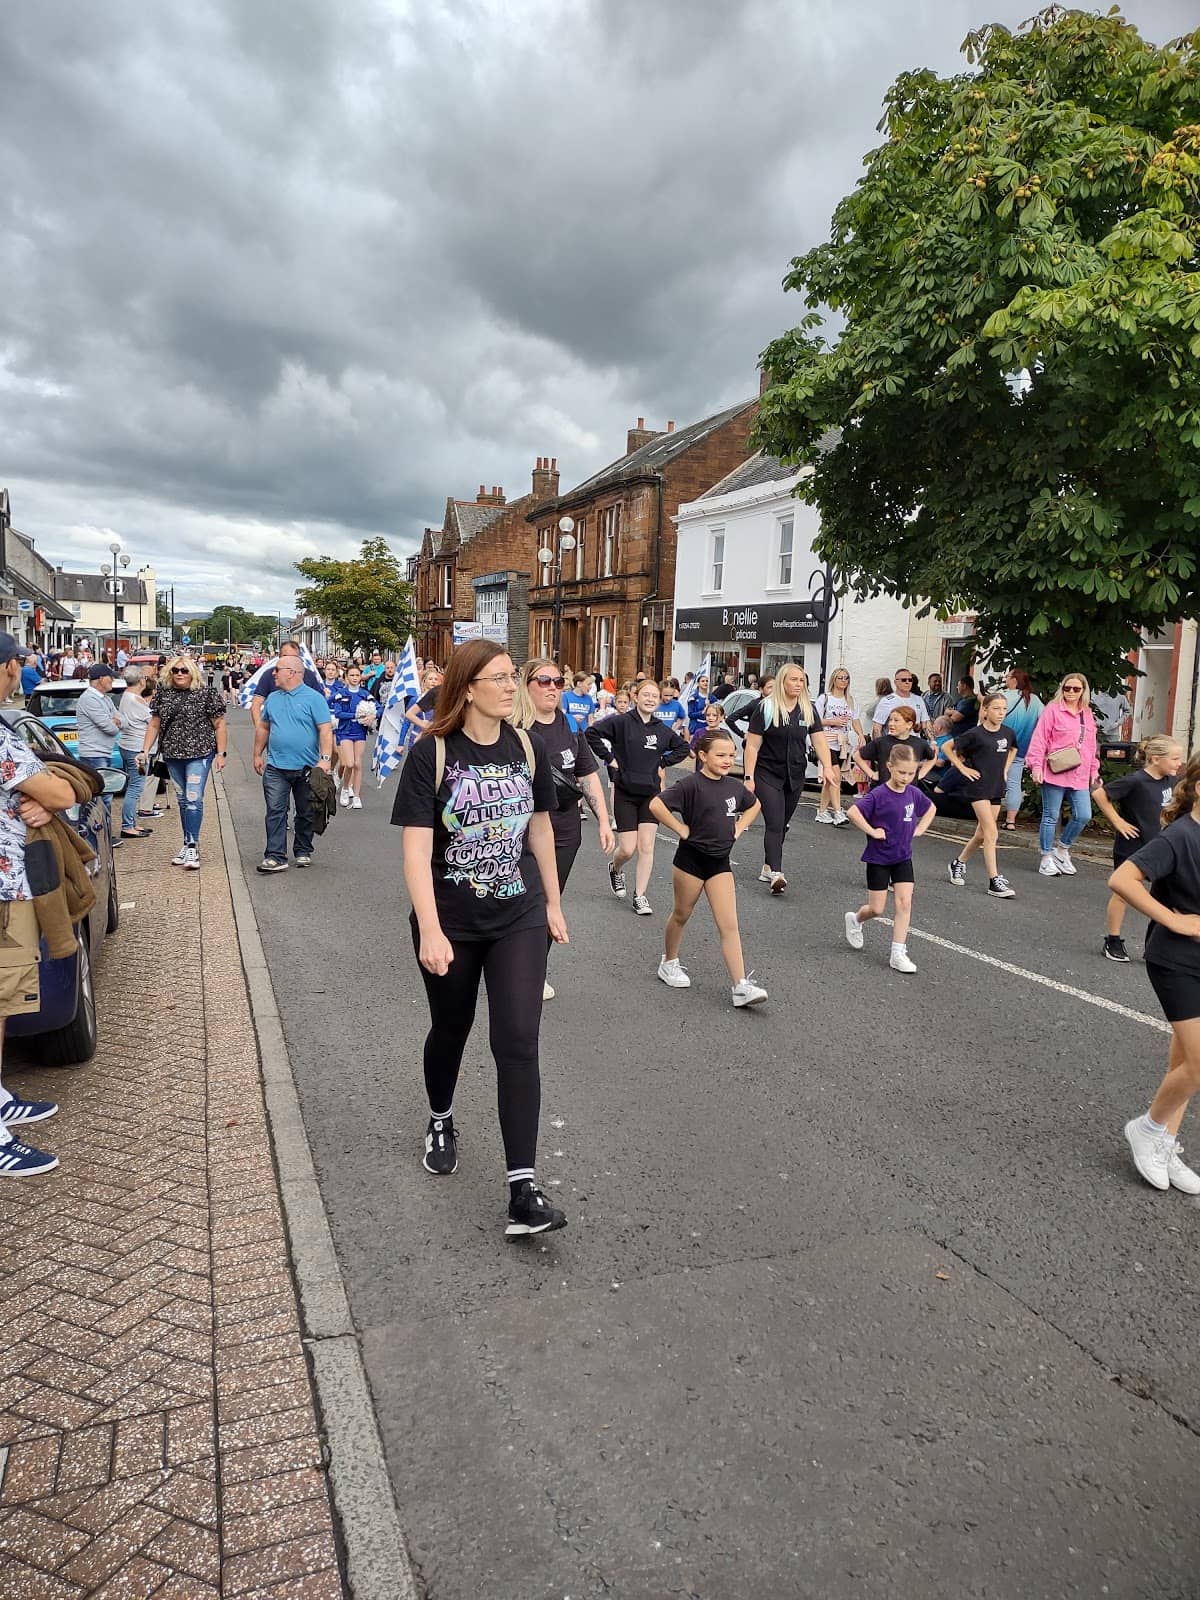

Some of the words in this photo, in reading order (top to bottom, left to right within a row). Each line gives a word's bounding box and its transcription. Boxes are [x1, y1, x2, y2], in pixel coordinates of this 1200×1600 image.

[723, 608, 758, 626] Bonellie
[730, 626, 757, 641] Opticians
[446, 841, 512, 865] Cheer
[497, 880, 525, 897] 2022
